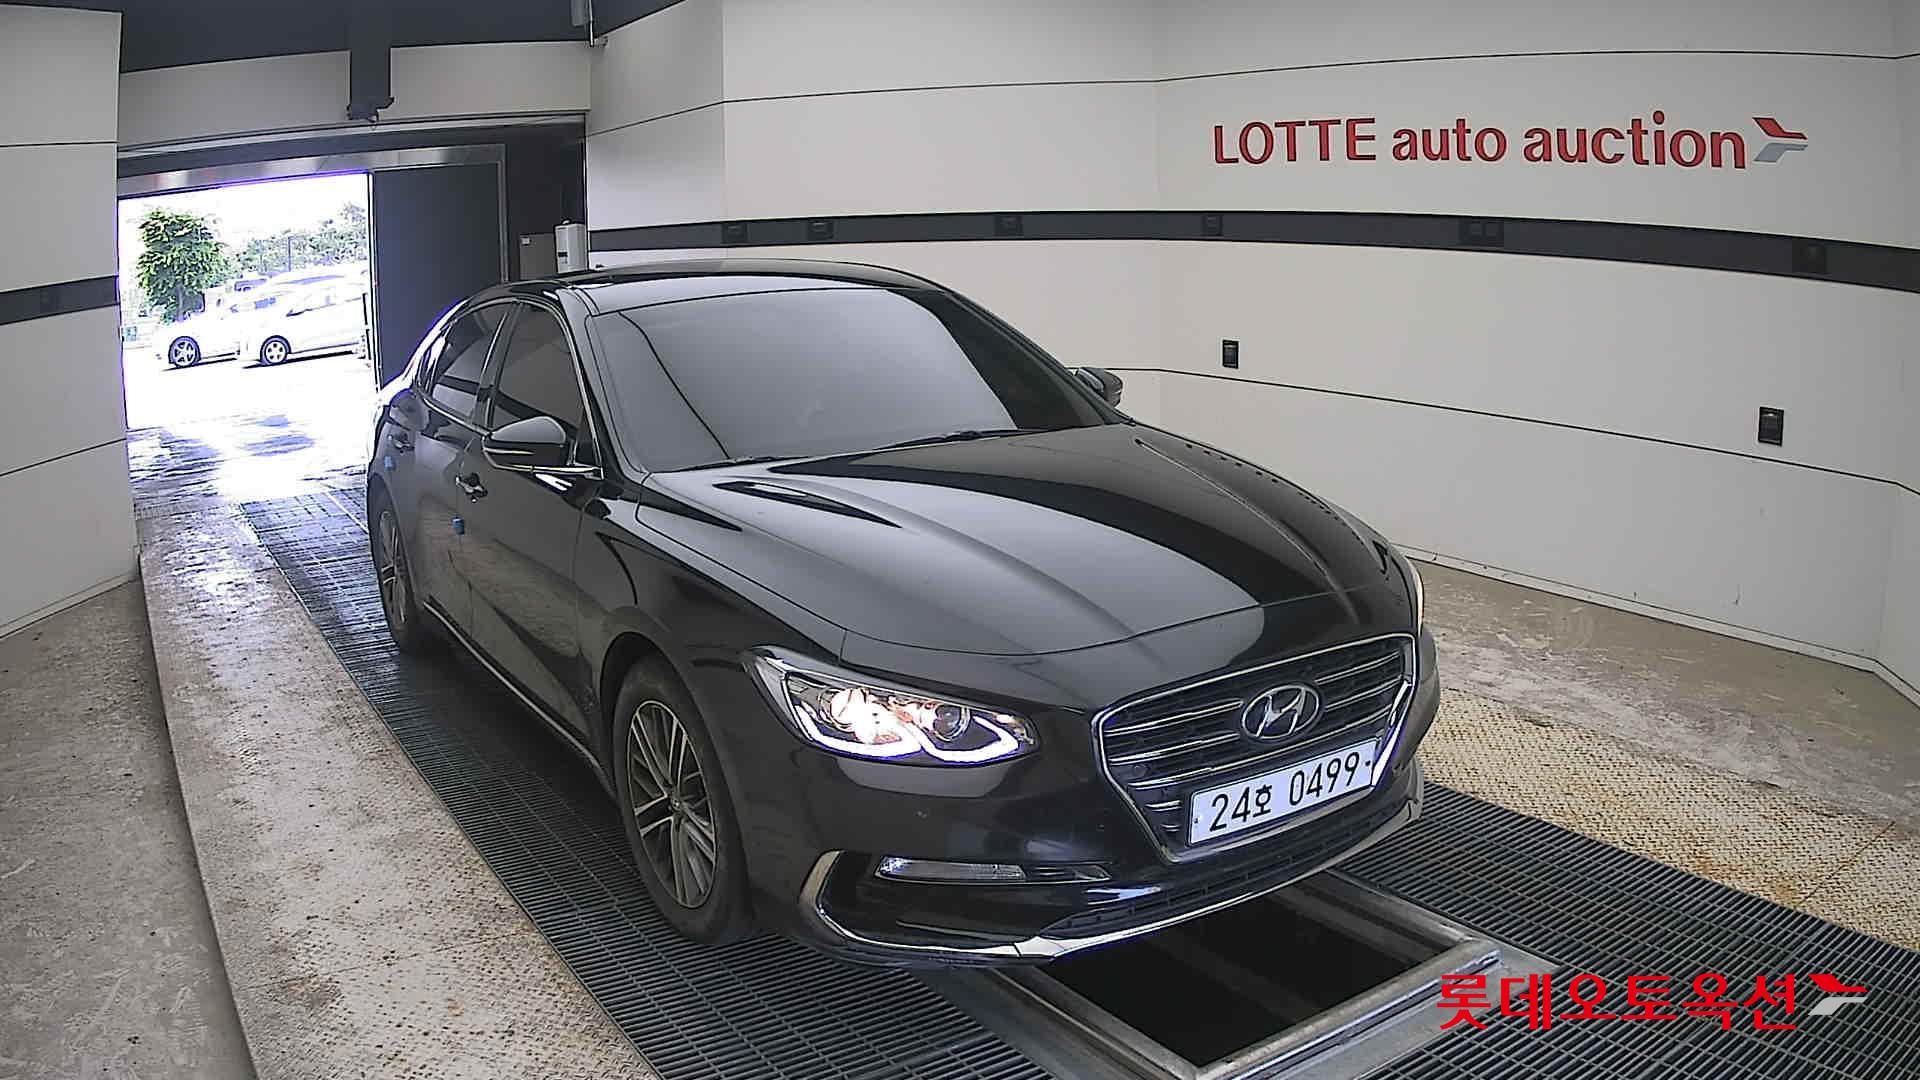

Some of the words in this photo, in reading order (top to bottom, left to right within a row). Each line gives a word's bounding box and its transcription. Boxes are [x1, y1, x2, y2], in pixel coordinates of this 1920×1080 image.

[1213, 117, 1376, 164] LOTTE
[1392, 117, 1508, 162] auto
[1522, 111, 1747, 170] auction
[1209, 784, 1273, 832] 24호
[1289, 752, 1360, 806] 0499
